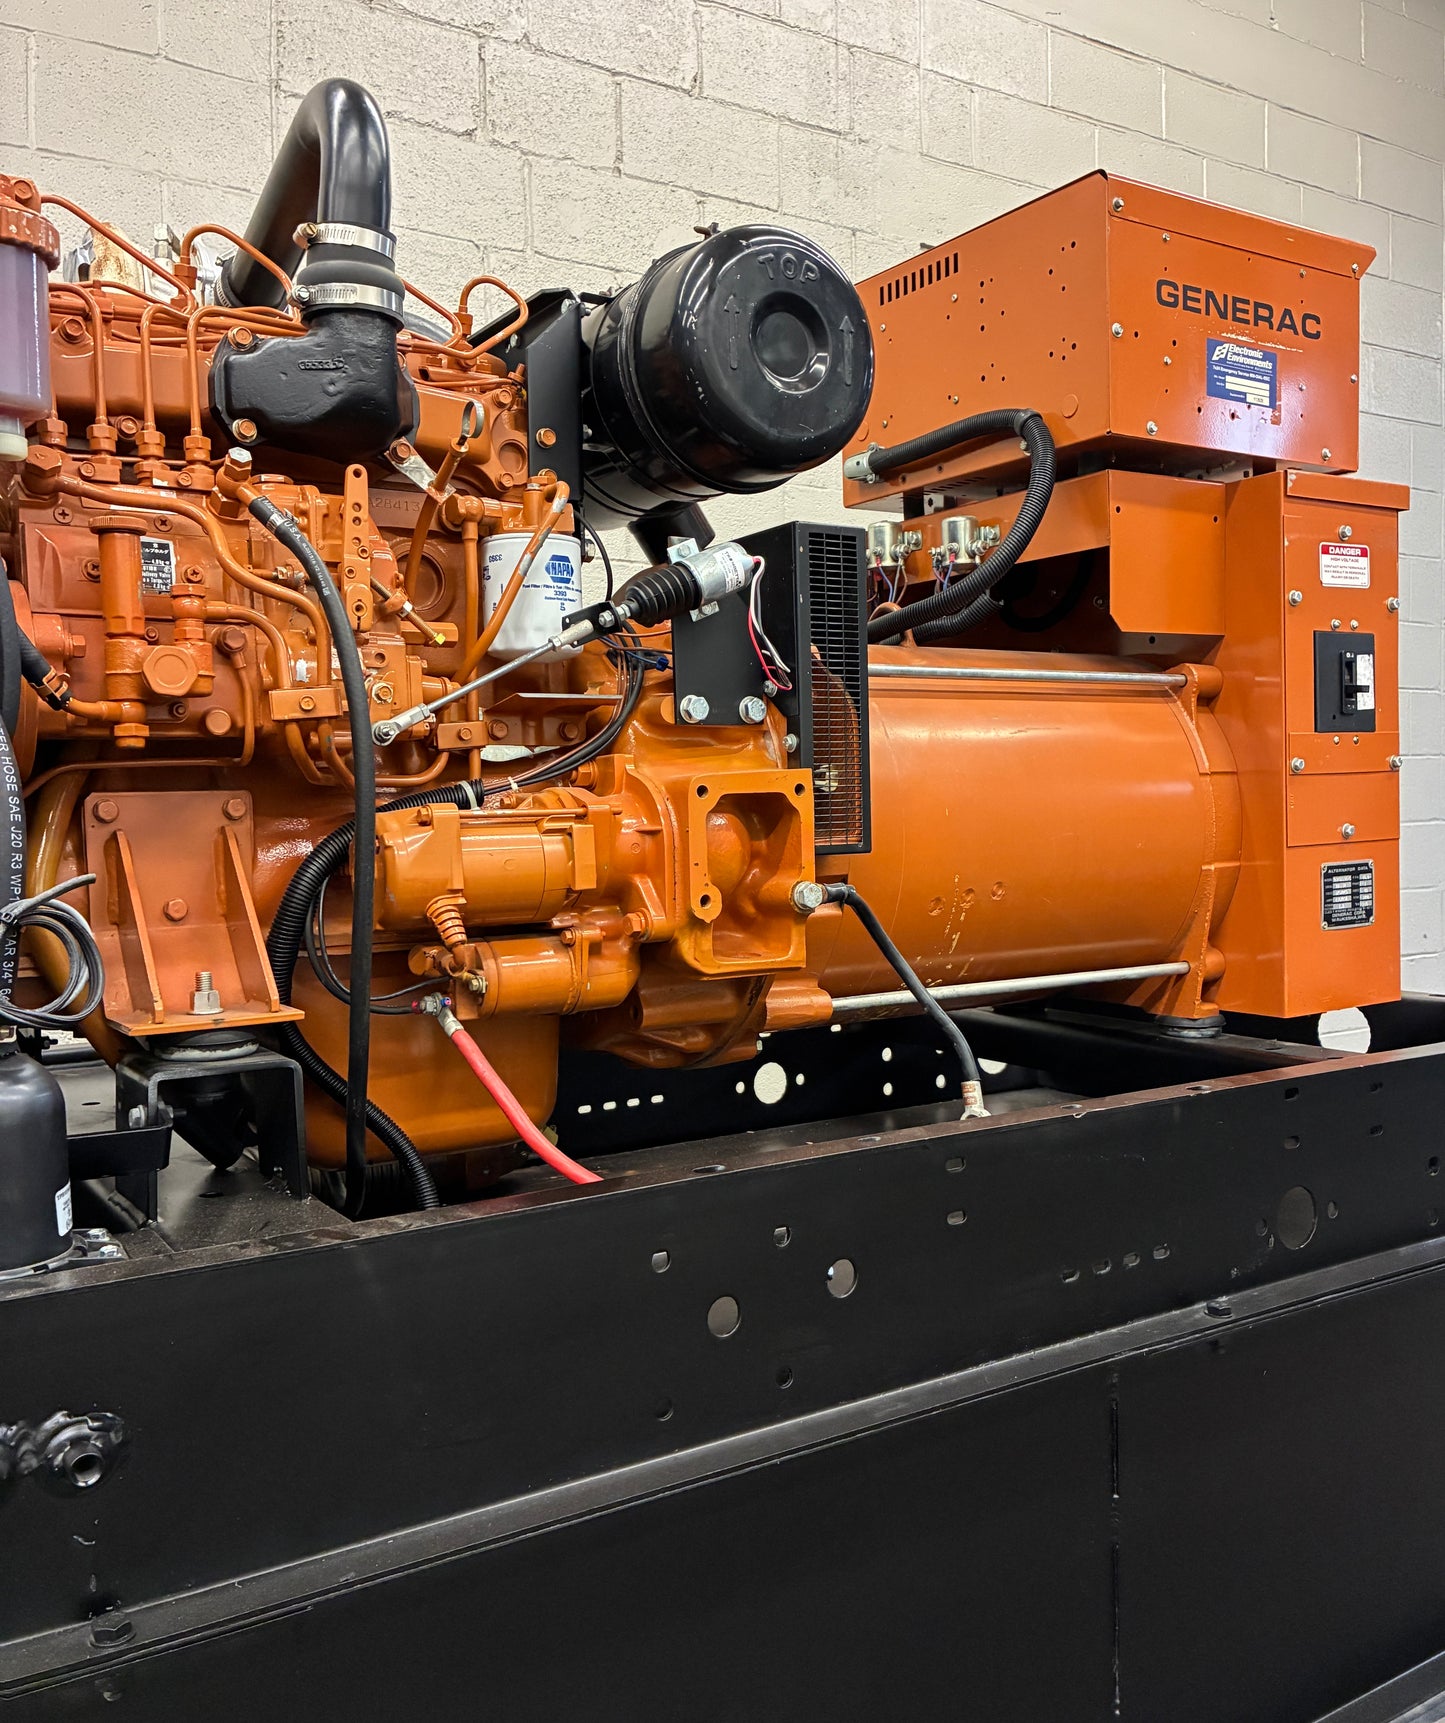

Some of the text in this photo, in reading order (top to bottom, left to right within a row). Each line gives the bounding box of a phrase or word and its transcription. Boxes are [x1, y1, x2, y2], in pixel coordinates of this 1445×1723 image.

[757, 253, 820, 283] TOP
[1156, 278, 1321, 340] GENERAC
[1226, 351, 1273, 370] Environments
[1228, 343, 1263, 359] Electronic
[284, 520, 301, 542] U.S.A.
[1329, 546, 1362, 557] DANGER
[551, 561, 571, 578] NAPA
[2, 756, 18, 792] HOSE
[8, 796, 21, 822] SAE
[11, 826, 23, 848] J20
[11, 853, 23, 869] R3
[1, 961, 14, 984] 3/4"
